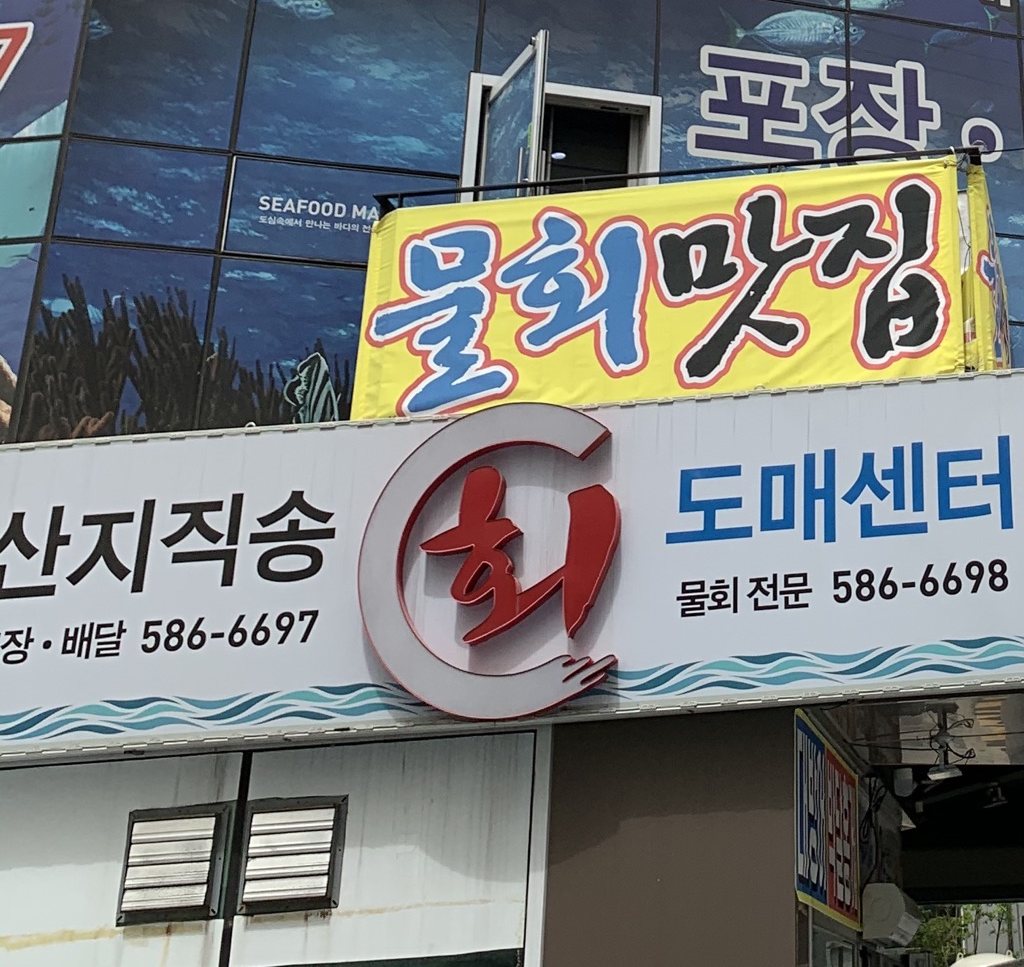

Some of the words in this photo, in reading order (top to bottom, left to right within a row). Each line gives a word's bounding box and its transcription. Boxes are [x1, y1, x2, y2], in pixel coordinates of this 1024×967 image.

[258, 195, 347, 218] SEAFOOD
[258, 215, 303, 228] 도심속에서
[305, 218, 332, 230] 만나는
[333, 221, 360, 233] 바다의
[665, 434, 1015, 546] 도매센터
[420, 465, 623, 645] 회
[675, 577, 740, 617] 물회
[747, 570, 814, 612] 전문
[832, 558, 1011, 605] 586-6698
[141, 609, 320, 654] 586-6697
